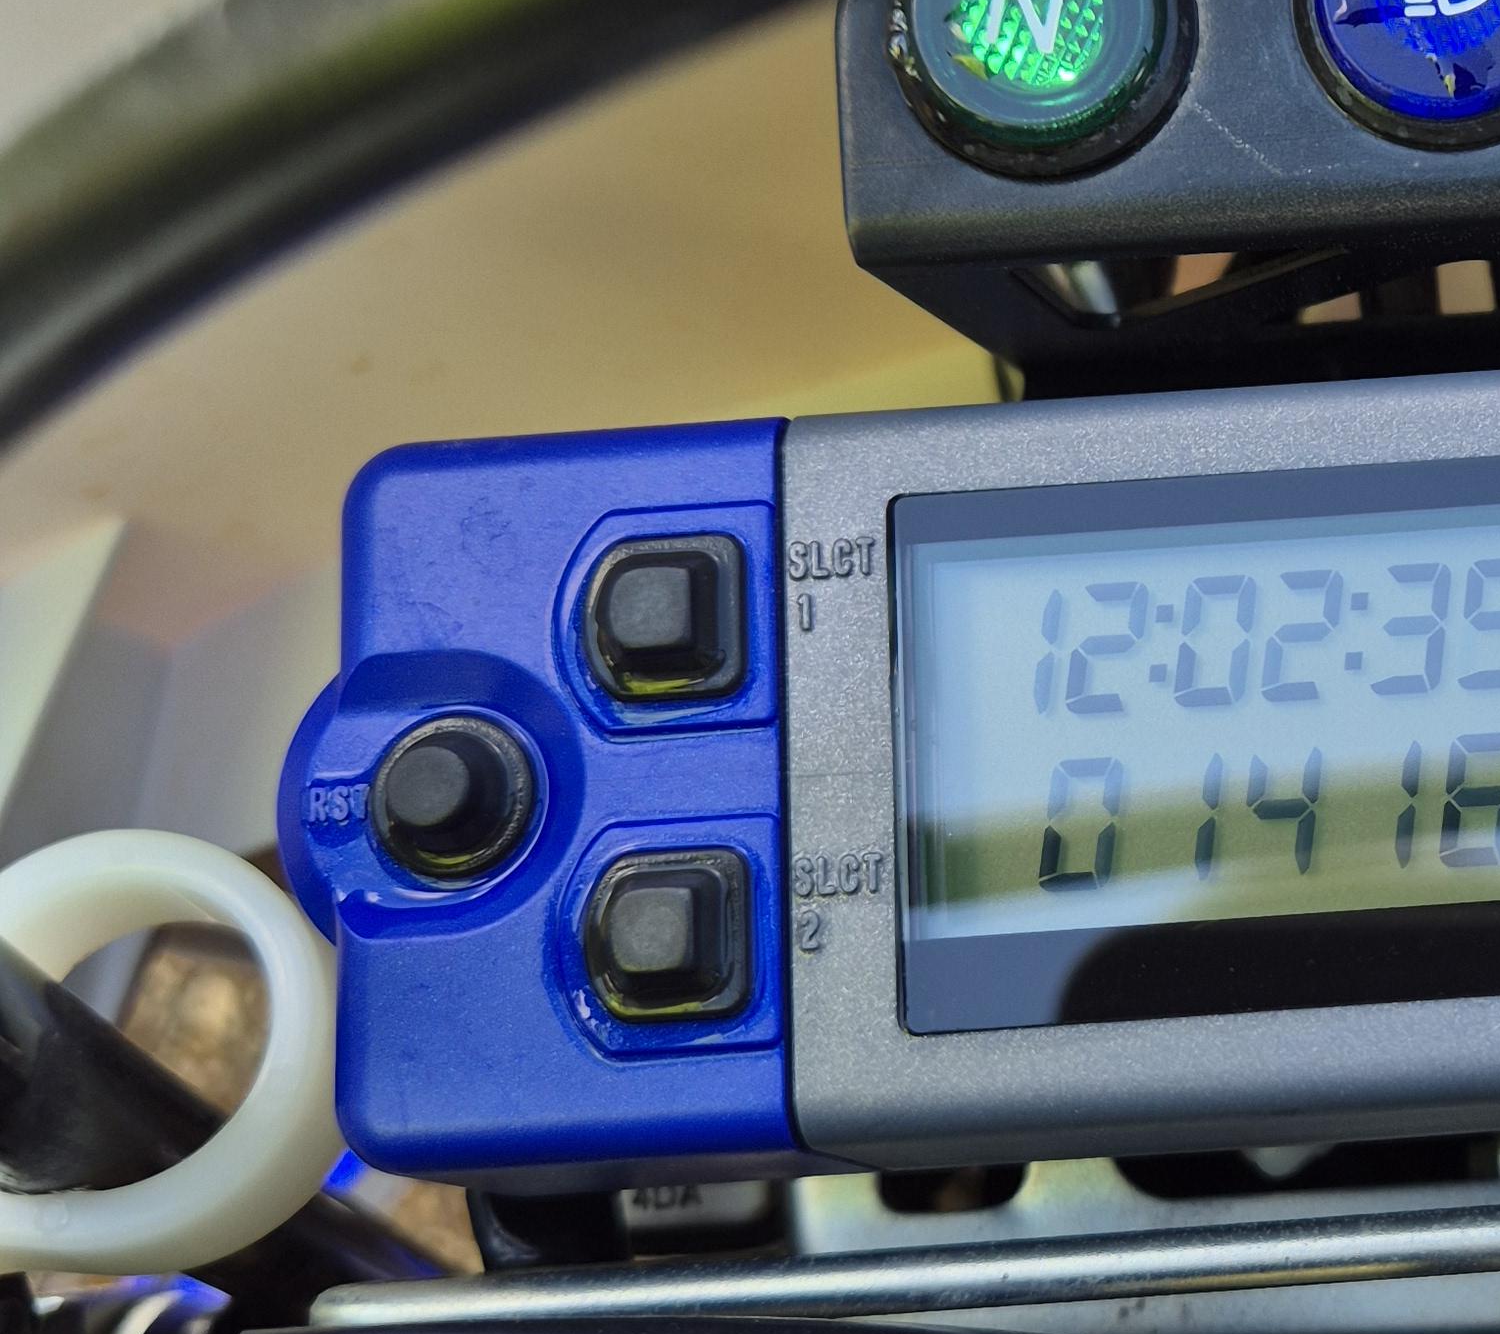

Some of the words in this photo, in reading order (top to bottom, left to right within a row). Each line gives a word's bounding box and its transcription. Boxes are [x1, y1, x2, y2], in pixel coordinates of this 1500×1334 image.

[788, 535, 876, 582] SLCT
[796, 592, 813, 632] 1
[308, 782, 370, 823] RST
[793, 851, 882, 897] SLCT
[799, 909, 821, 952] 2
